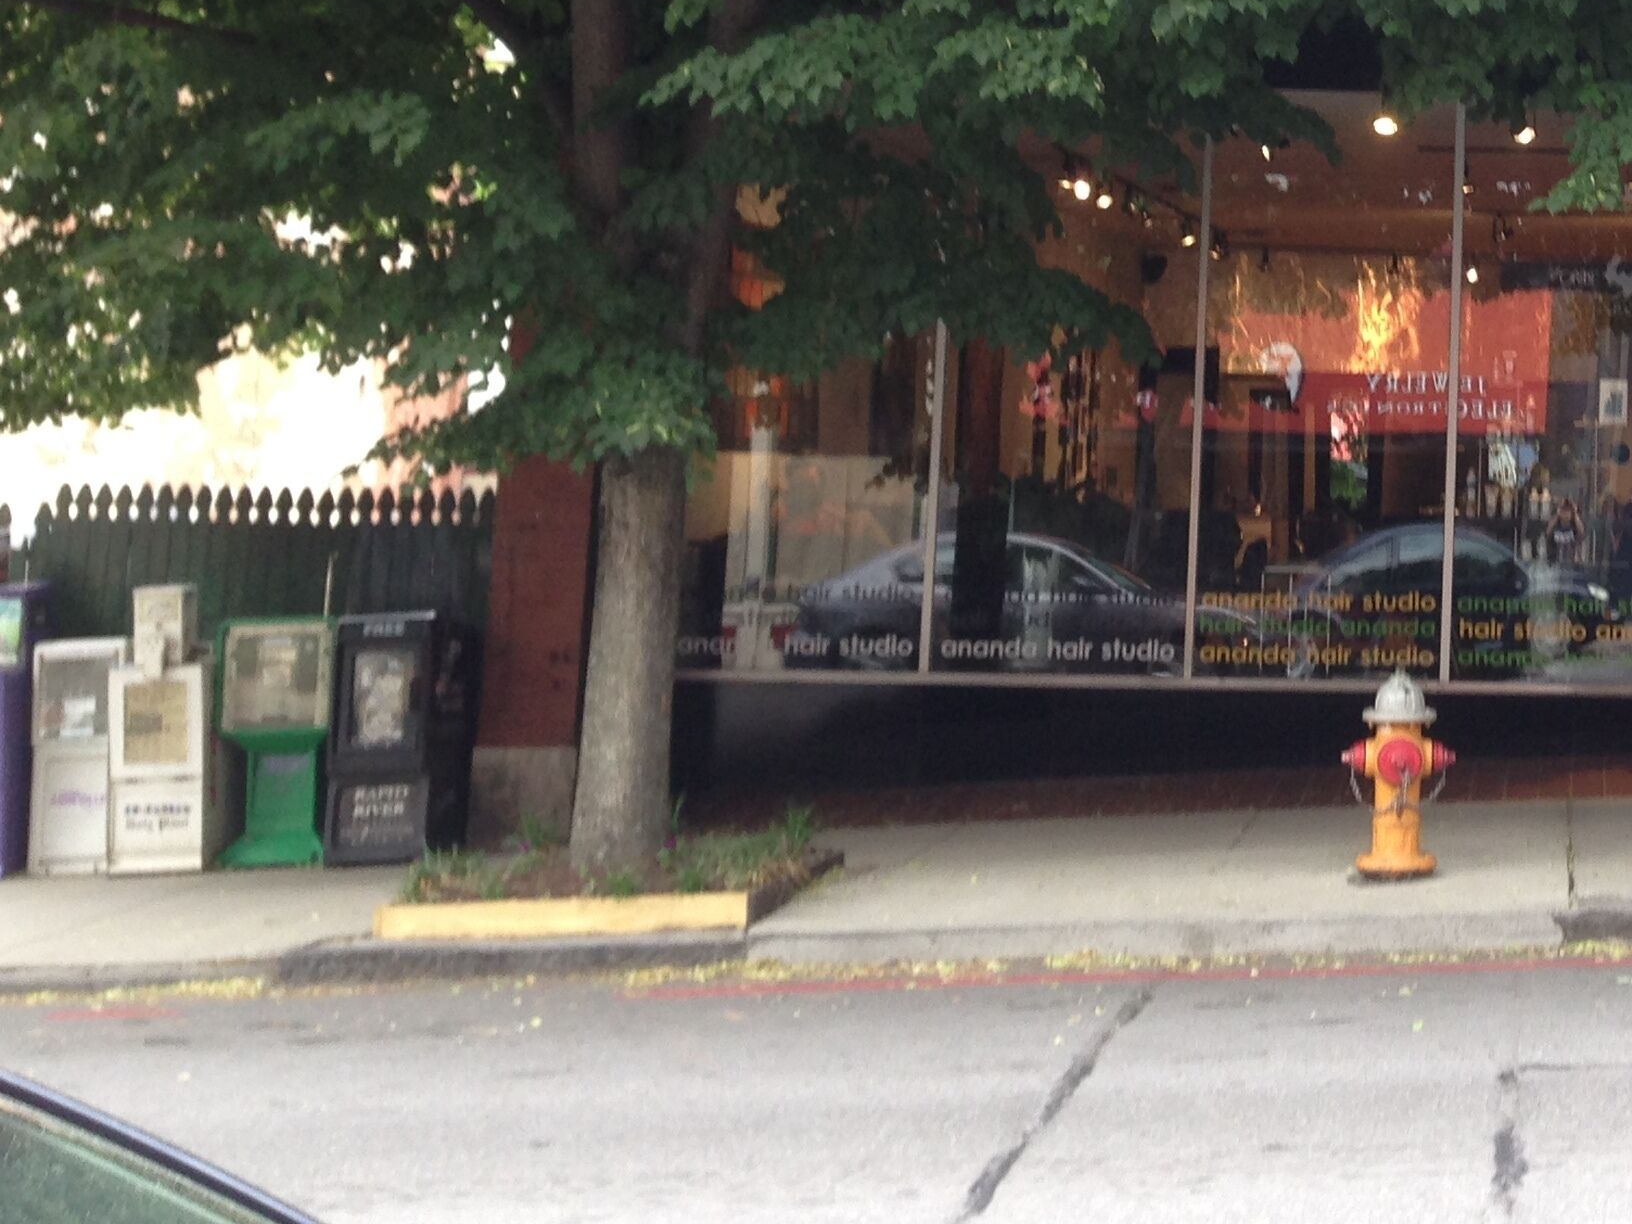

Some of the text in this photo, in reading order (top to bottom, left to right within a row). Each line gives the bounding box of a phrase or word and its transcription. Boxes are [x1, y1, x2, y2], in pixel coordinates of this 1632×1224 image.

[1202, 589, 1298, 610] ananda
[1309, 590, 1353, 611] hair
[1363, 590, 1436, 613] studio
[1458, 617, 1504, 640] hair
[784, 633, 831, 655] hair
[839, 633, 914, 658] studio
[940, 636, 1176, 663] ananda hair studio
[1200, 642, 1435, 667] ananda hair studio
